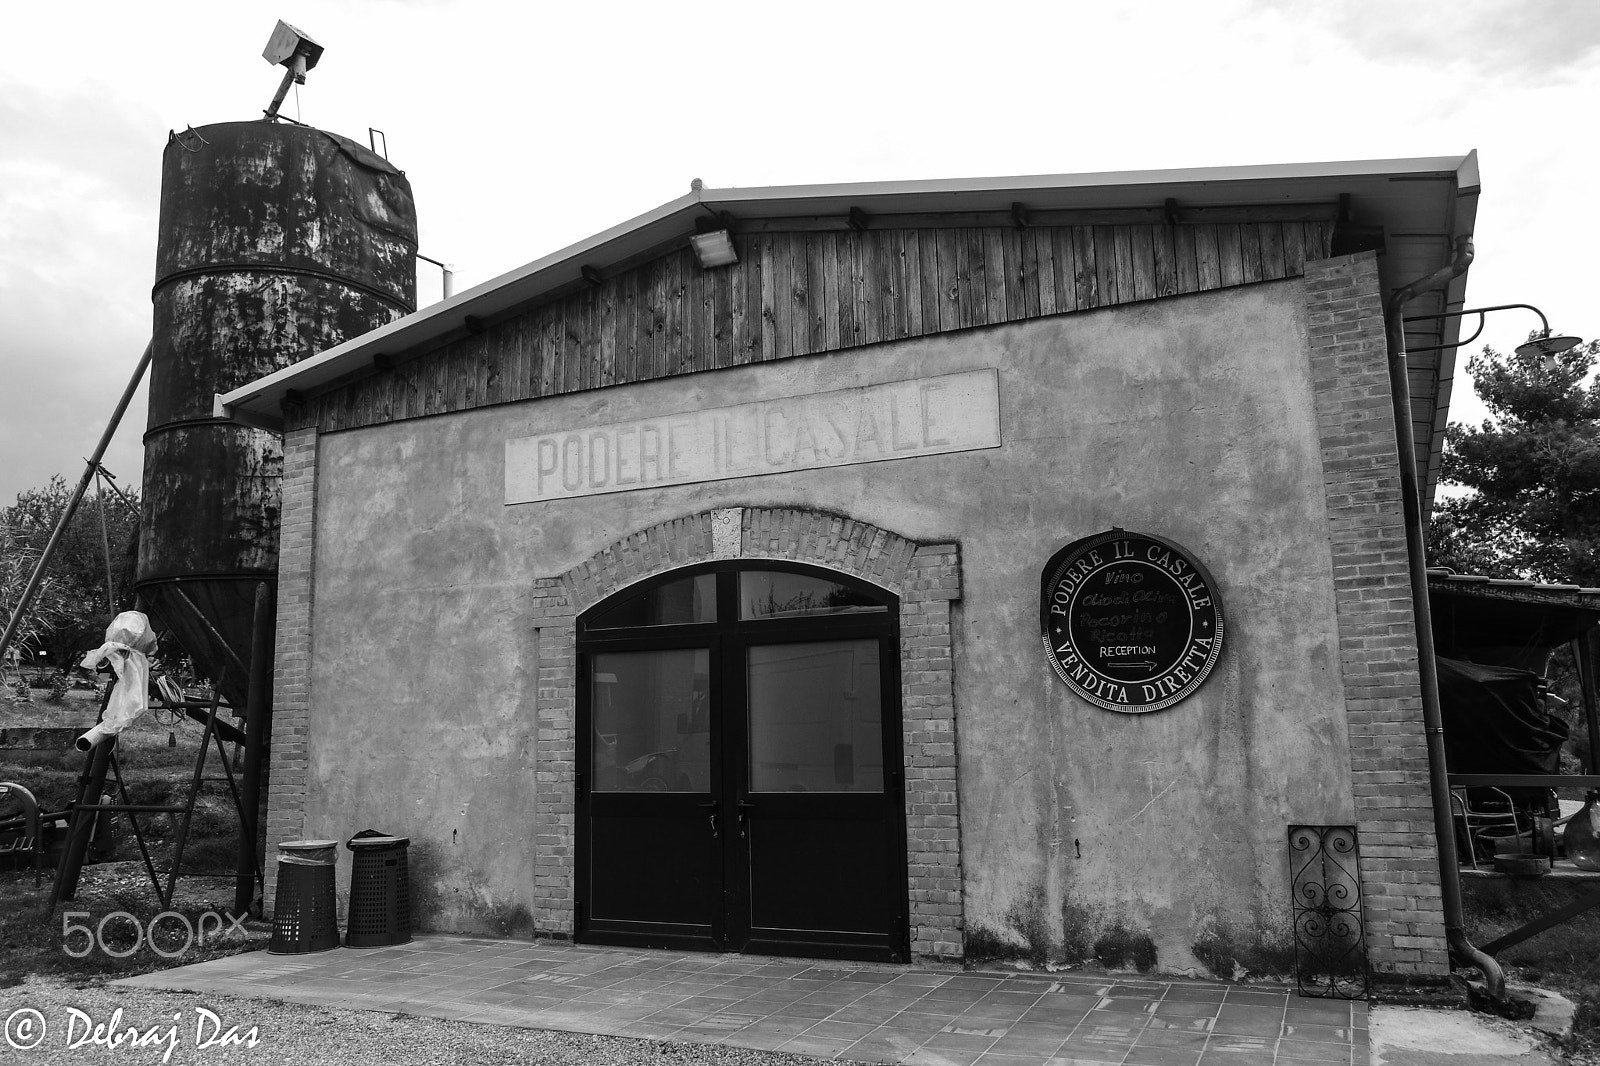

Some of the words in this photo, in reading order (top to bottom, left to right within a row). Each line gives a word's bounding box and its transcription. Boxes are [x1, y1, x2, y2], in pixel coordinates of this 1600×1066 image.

[537, 417, 691, 495] PODERE
[713, 415, 750, 474] IL
[764, 383, 951, 468] CASALE
[1051, 549, 1103, 616] PODERE
[1112, 541, 1135, 559] IL
[1147, 545, 1212, 610] CASALE
[1105, 569, 1144, 585] Vino
[1056, 640, 1129, 703] VENDITA
[1141, 636, 1213, 702] DIRETTA
[1100, 645, 1156, 658] RECEPTION
